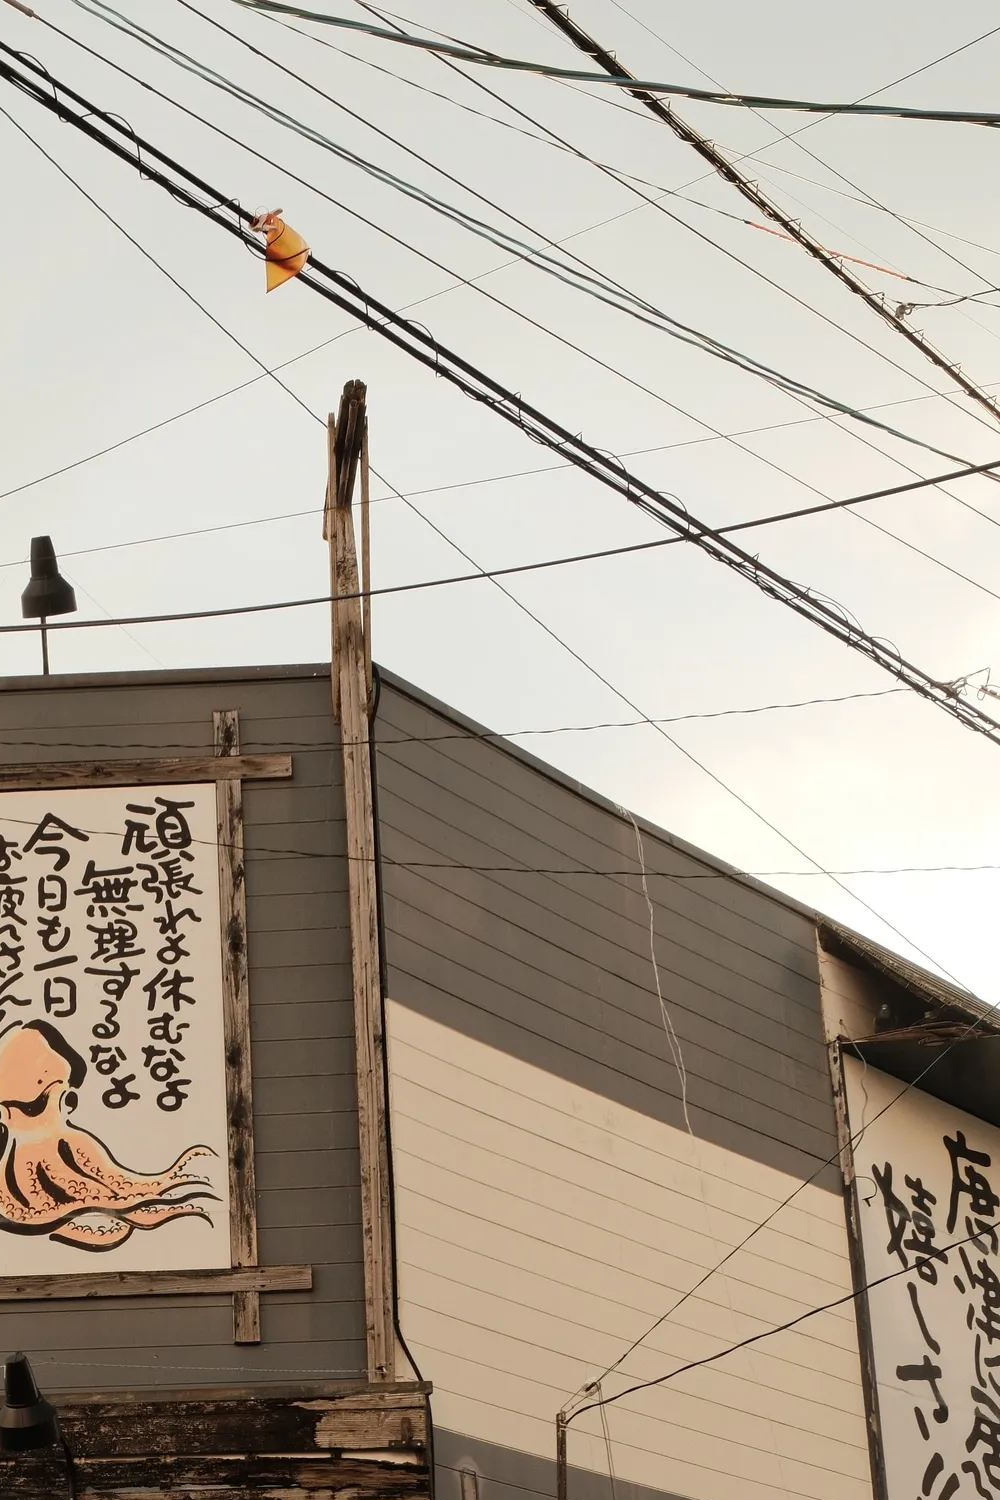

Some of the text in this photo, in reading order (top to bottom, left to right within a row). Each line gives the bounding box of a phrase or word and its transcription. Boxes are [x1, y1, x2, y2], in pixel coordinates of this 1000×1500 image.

[22, 812, 90, 1018] 今日も一日
[74, 859, 145, 1110] 無理するなよ
[121, 797, 202, 1112] 頑張れよ休むなよ
